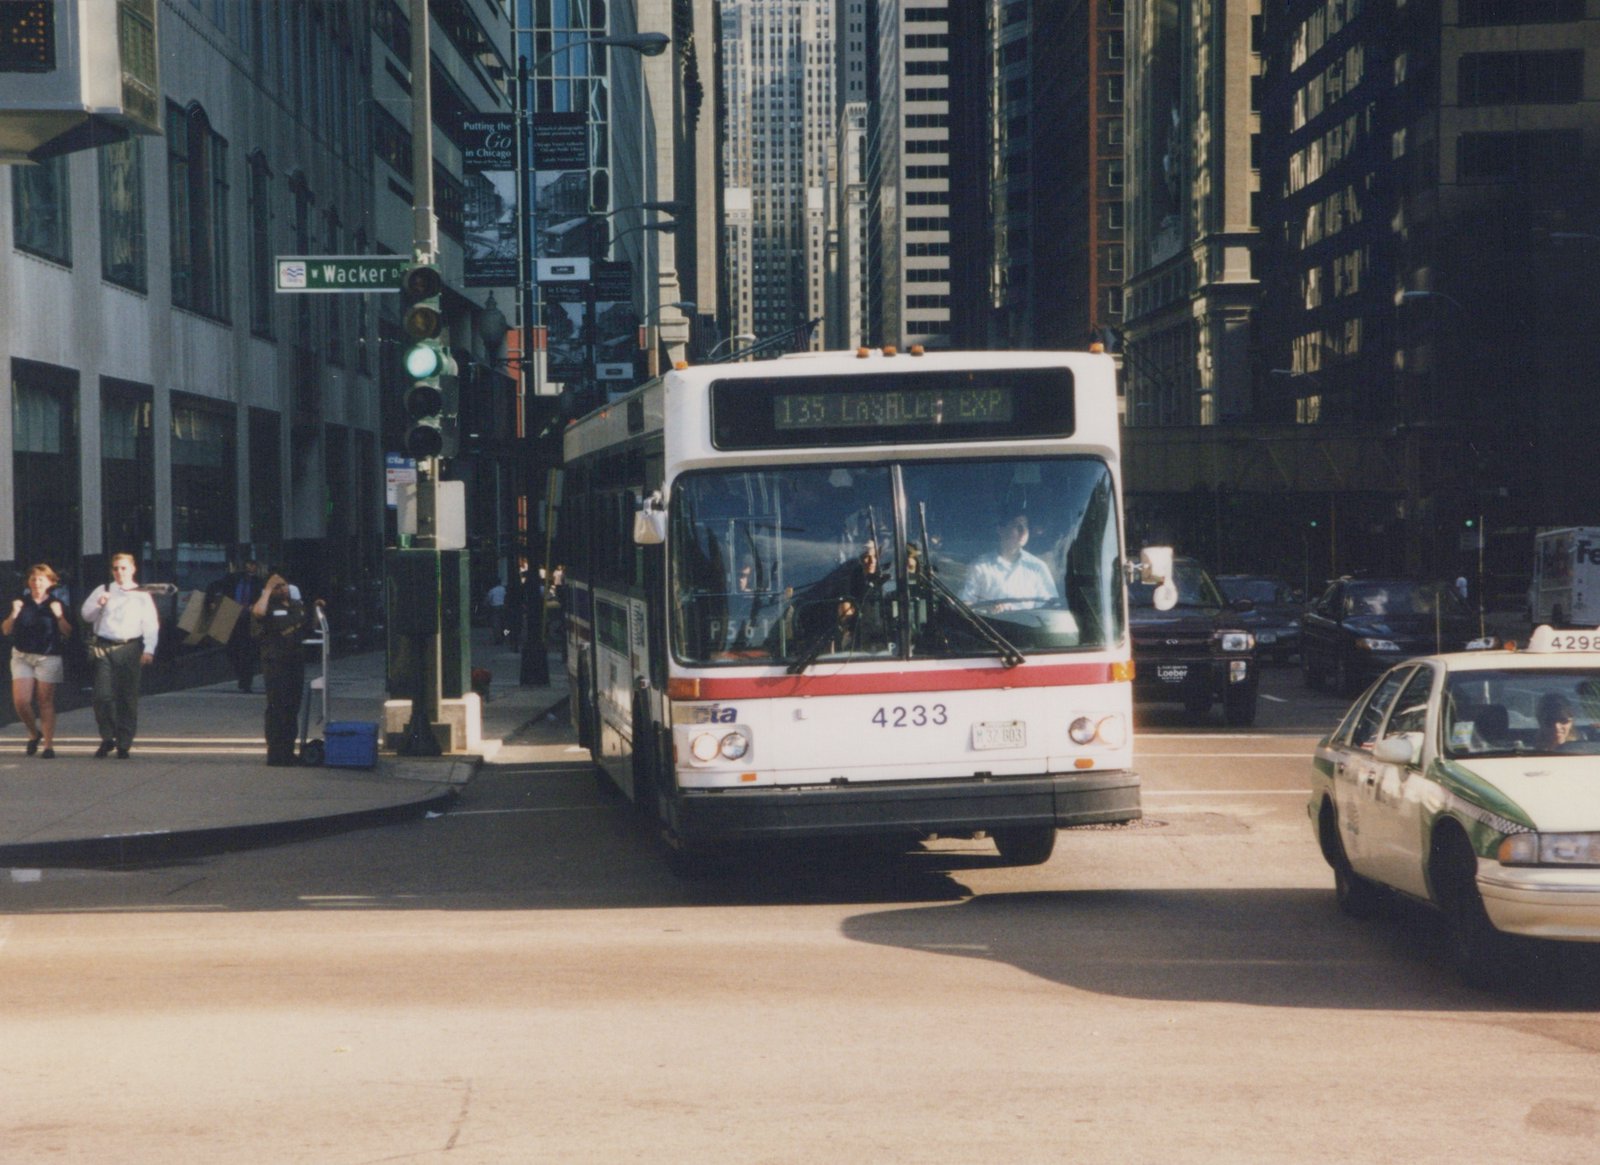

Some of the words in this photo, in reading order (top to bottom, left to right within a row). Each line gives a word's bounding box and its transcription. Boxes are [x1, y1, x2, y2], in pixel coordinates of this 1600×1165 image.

[463, 122, 495, 133] Putting
[497, 121, 511, 130] the
[485, 132, 512, 149] Go
[465, 148, 474, 157] in
[476, 148, 512, 159] Chicago
[311, 269, 318, 278] W
[323, 265, 387, 283] Wacker
[783, 395, 825, 423] 135
[960, 389, 1001, 417] EXP
[1551, 636, 1600, 650] 4298
[1157, 667, 1188, 677] Loeber
[871, 703, 948, 728] 4233
